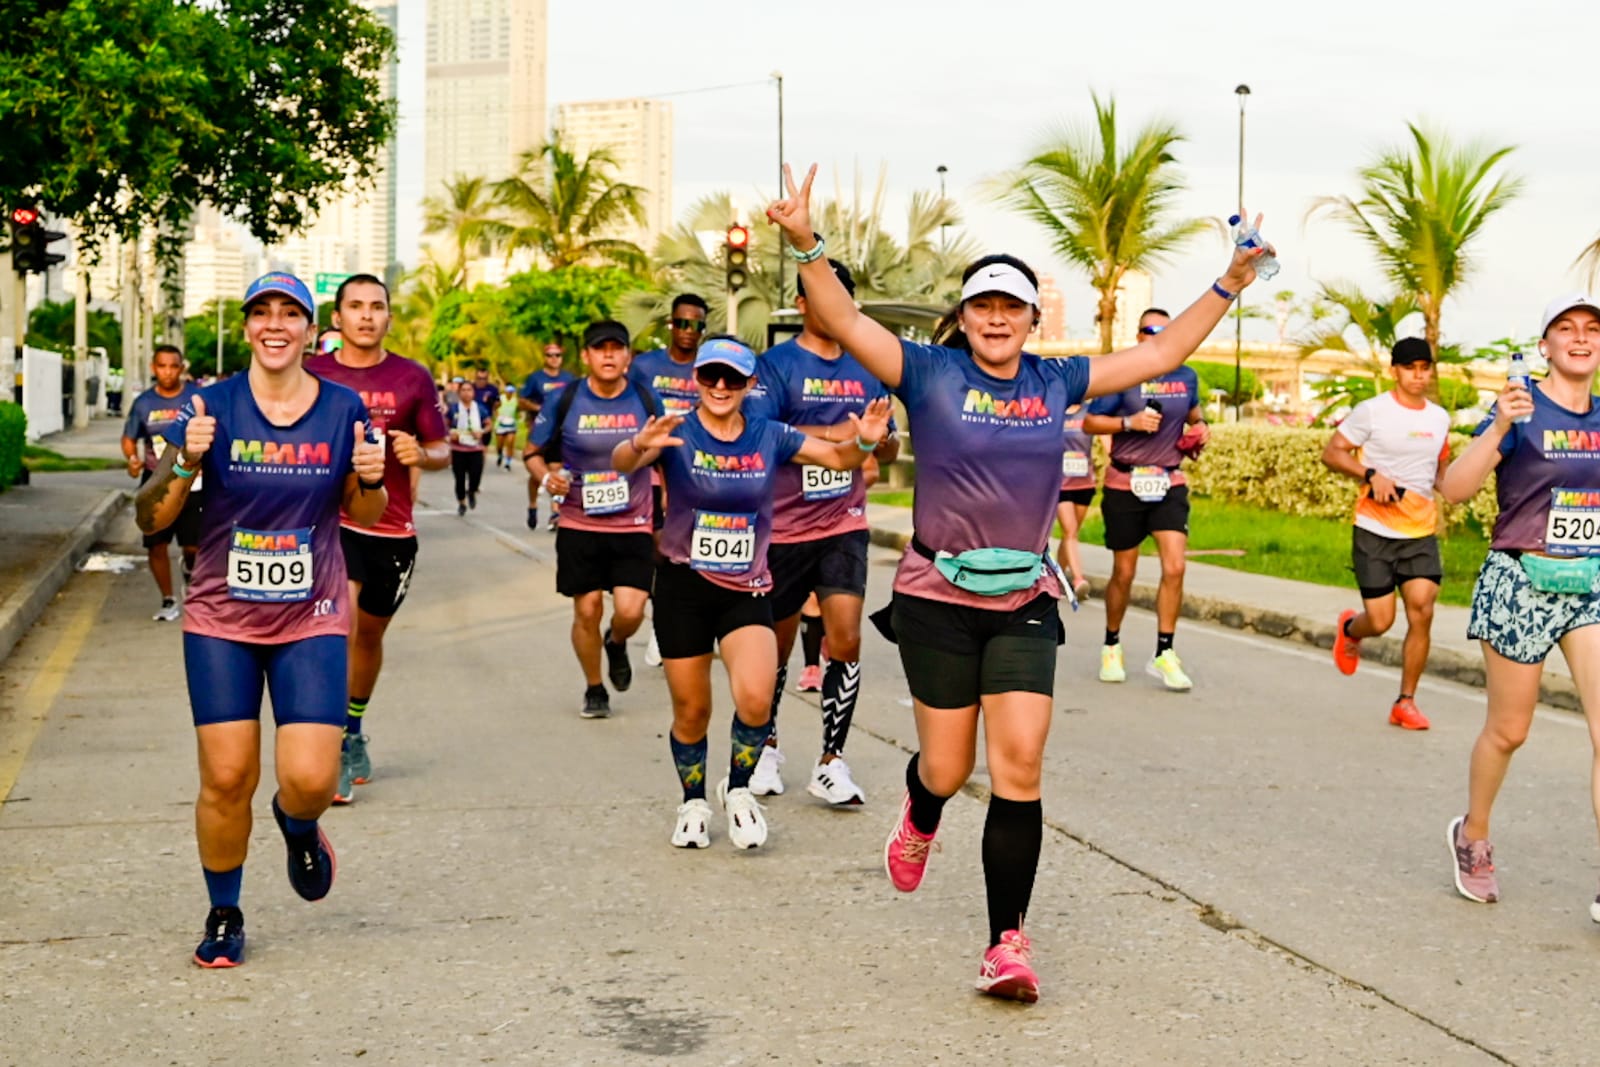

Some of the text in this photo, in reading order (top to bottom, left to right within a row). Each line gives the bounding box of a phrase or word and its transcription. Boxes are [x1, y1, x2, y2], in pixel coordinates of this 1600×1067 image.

[803, 377, 866, 397] MMM
[963, 389, 1051, 419] MMM
[578, 413, 638, 429] MMM
[962, 413, 986, 423] MEDIA
[230, 439, 330, 465] MMM
[694, 449, 766, 470] MMM
[586, 486, 625, 504] 5295
[1134, 480, 1169, 494] 6074
[234, 531, 298, 550] MMM
[699, 537, 750, 559] 5041
[237, 560, 305, 586] 5109
